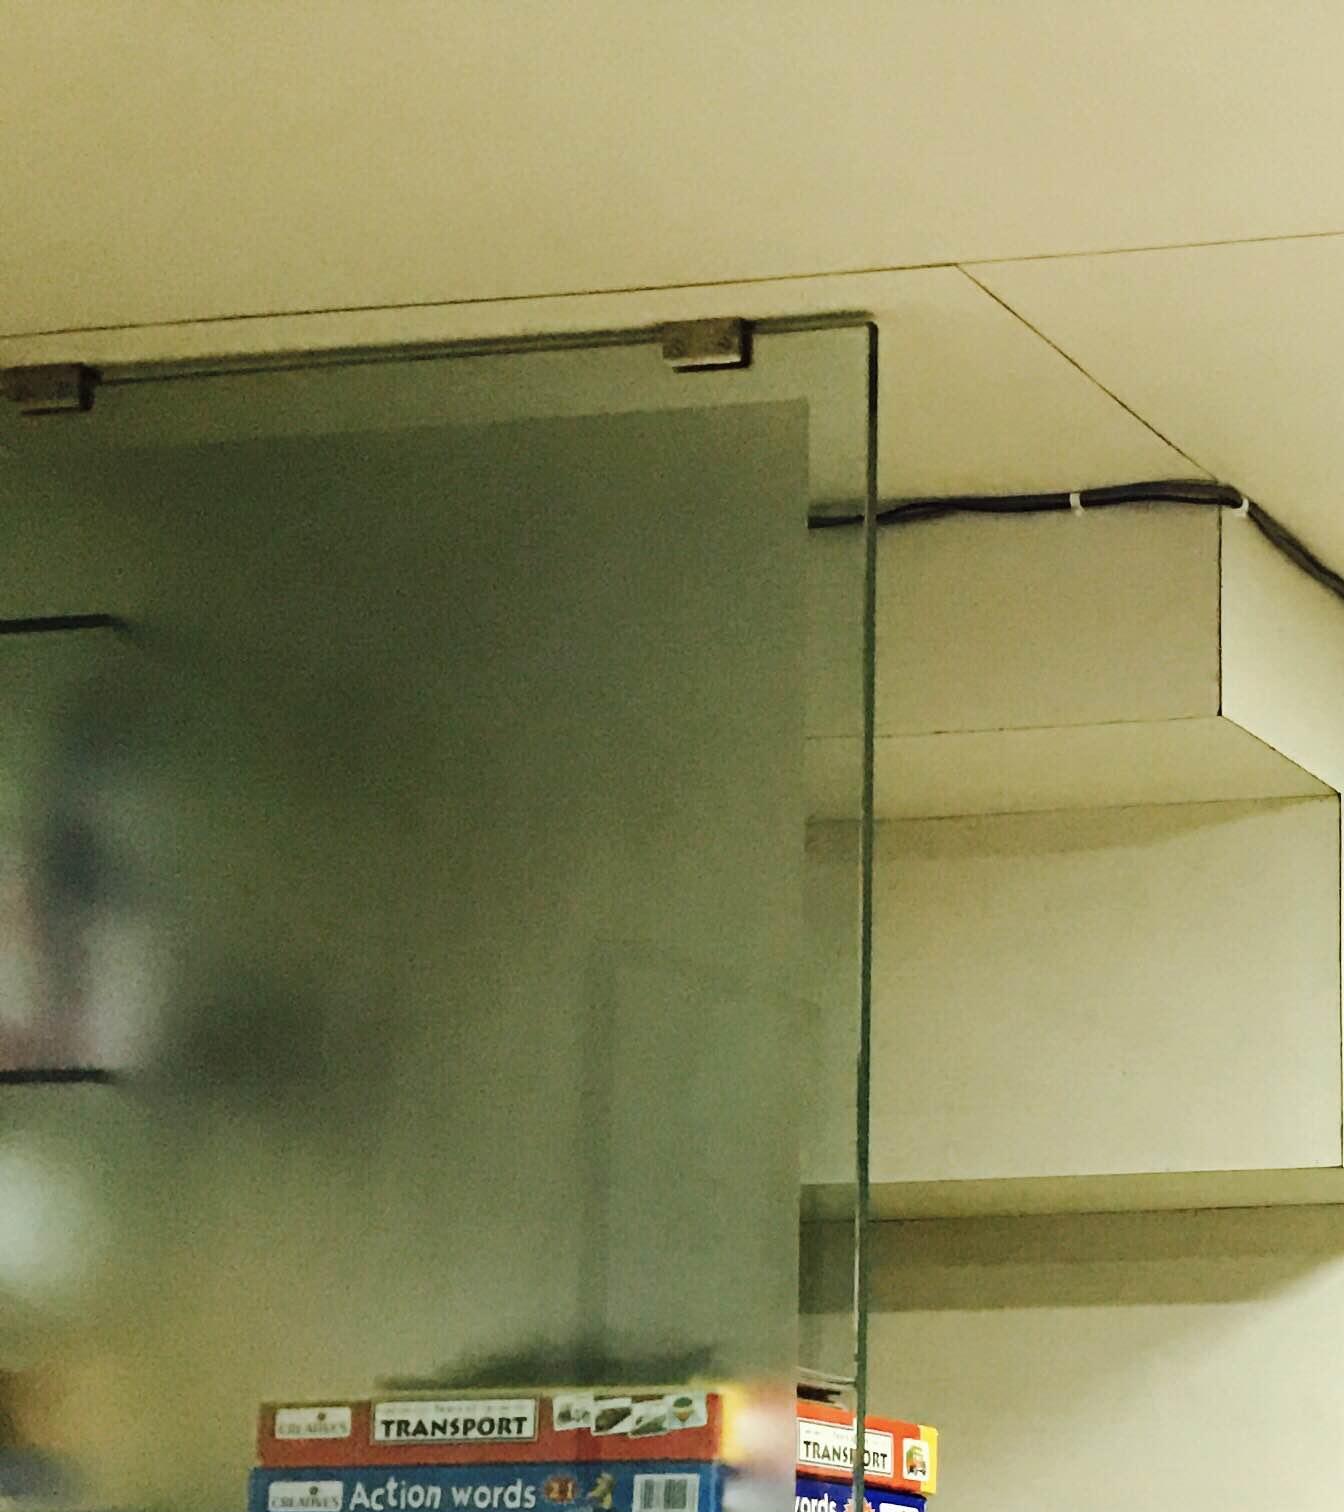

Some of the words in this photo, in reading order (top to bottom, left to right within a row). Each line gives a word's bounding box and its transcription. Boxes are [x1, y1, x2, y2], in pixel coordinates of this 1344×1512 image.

[381, 1416, 528, 1438] TRANSPORT
[350, 1475, 442, 1512] Action
[451, 1477, 537, 1509] words
